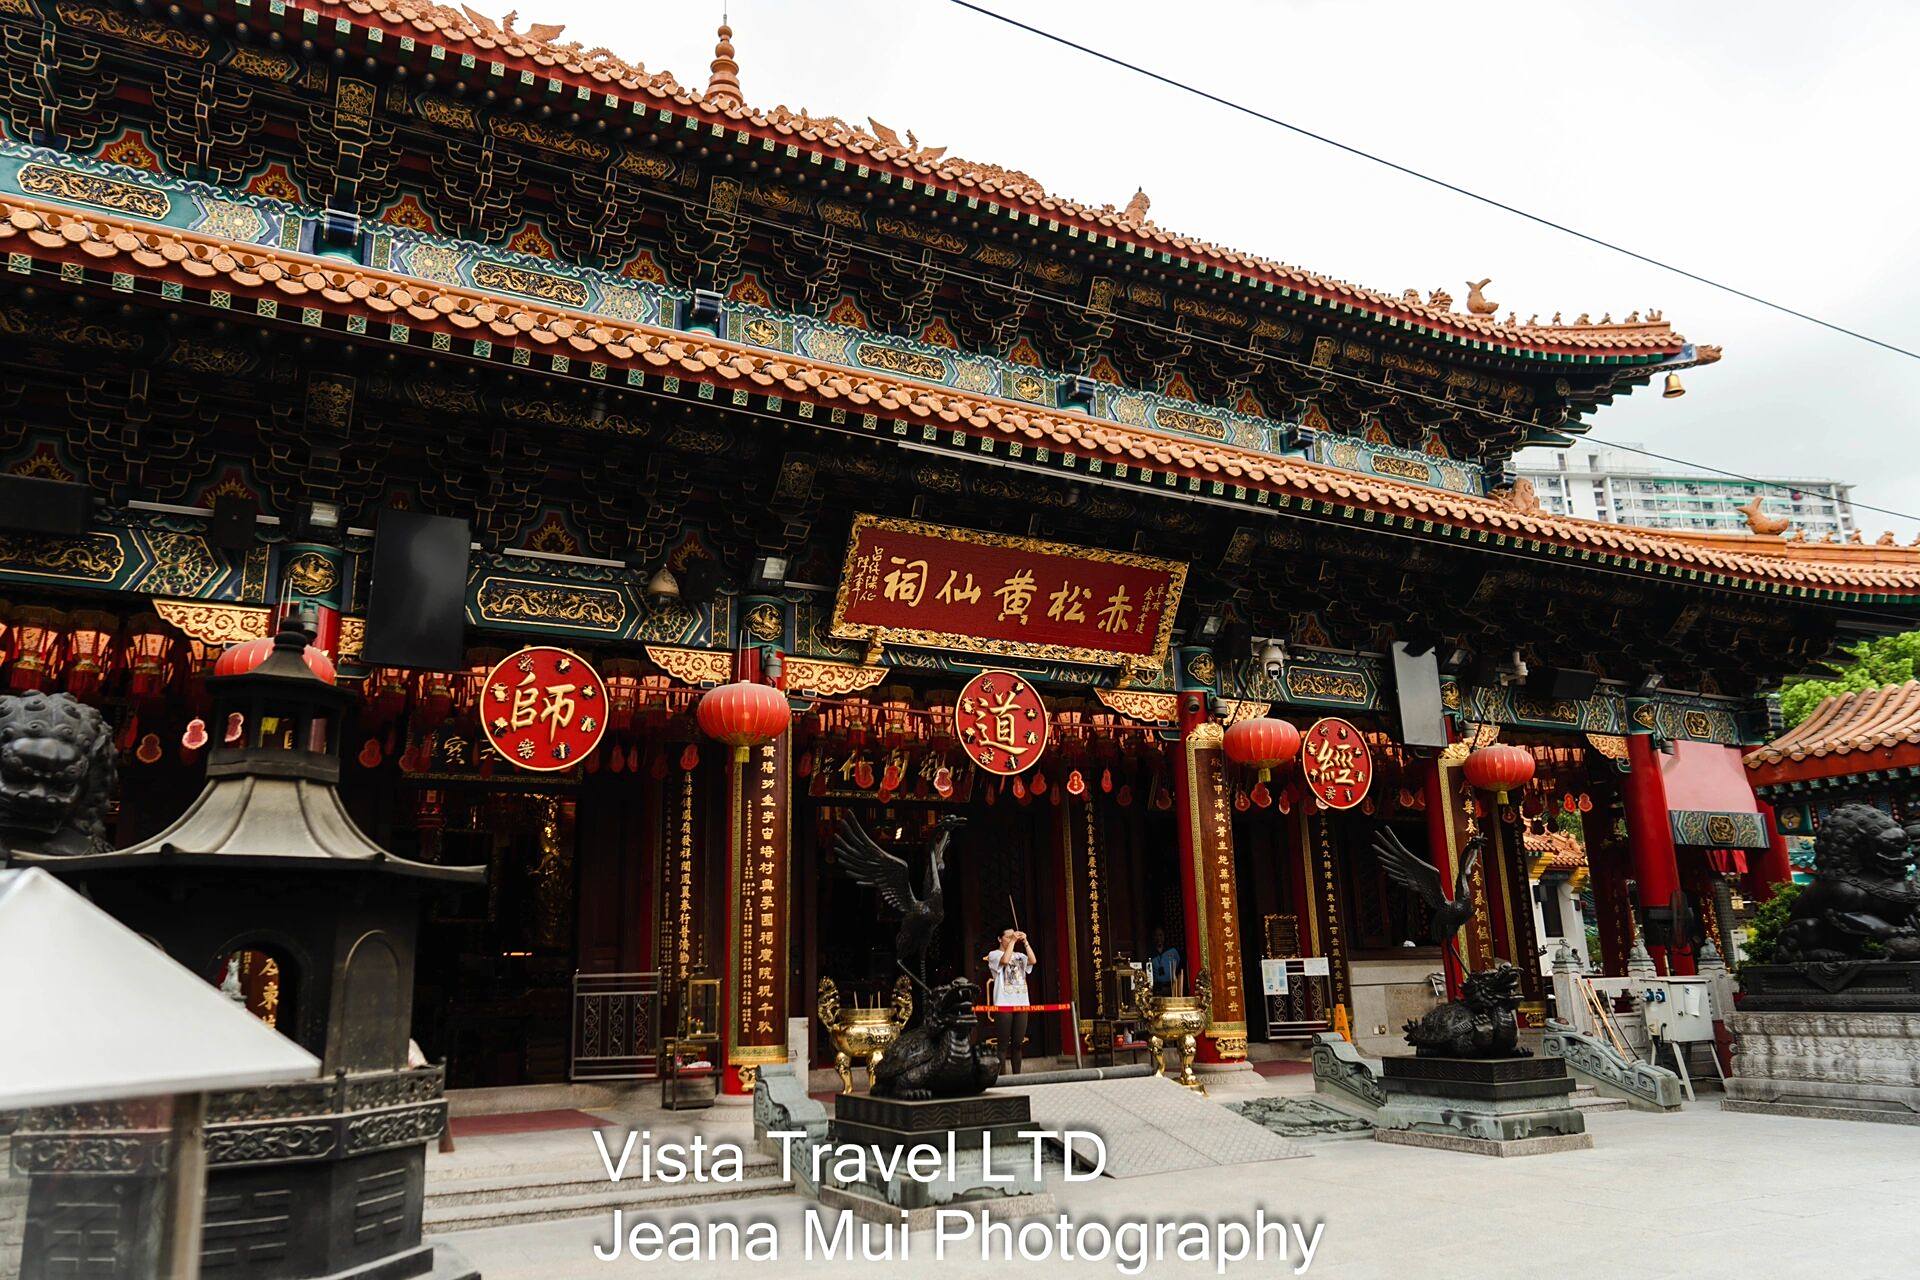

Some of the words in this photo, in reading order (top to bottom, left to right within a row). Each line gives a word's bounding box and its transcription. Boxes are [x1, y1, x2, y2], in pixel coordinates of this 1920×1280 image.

[511, 671, 577, 744] 師
[975, 690, 1029, 755] 道
[1317, 739, 1356, 785] 經
